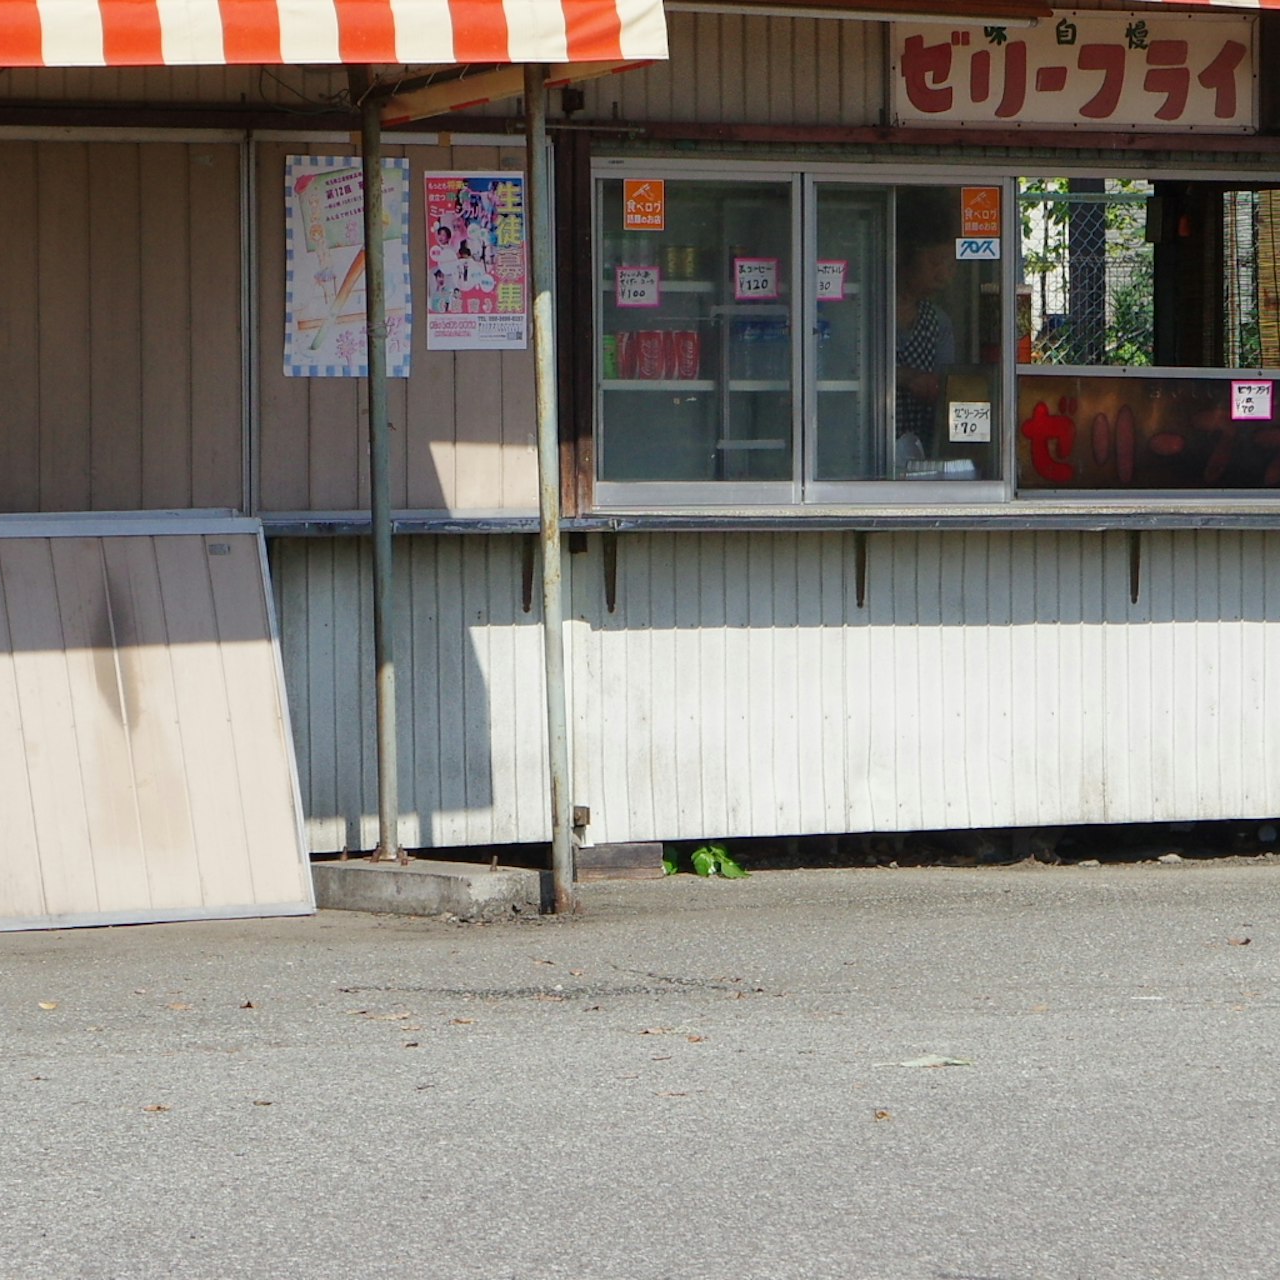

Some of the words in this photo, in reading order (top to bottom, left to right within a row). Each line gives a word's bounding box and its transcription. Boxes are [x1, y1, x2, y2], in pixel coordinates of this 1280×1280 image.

[901, 31, 1247, 121] ゼリーフライ
[626, 199, 661, 213] 食べログ
